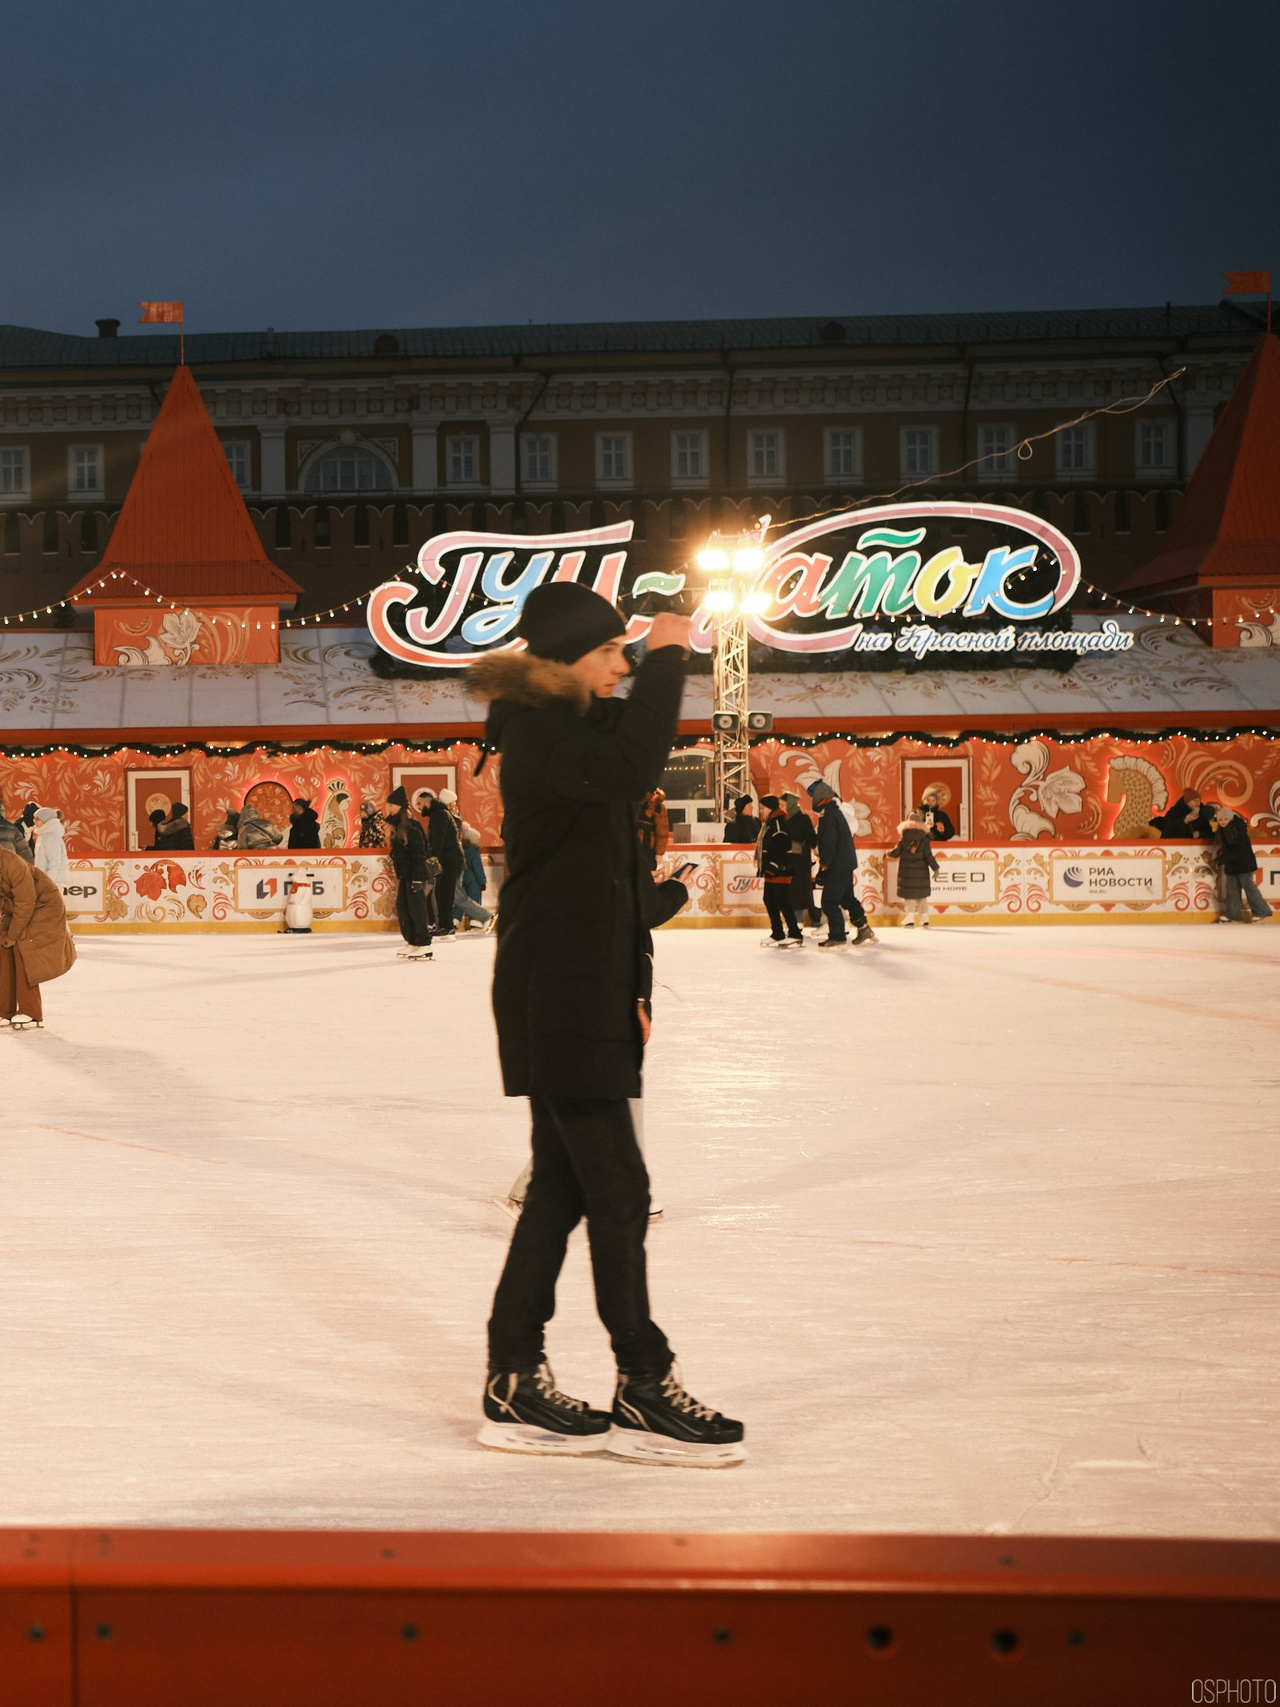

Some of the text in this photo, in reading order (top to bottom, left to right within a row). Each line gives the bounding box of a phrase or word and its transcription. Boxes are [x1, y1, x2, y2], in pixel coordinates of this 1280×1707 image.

[855, 620, 1133, 660] на Красной площади
[1089, 867, 1115, 876] РИА
[934, 872, 985, 883] EED
[1089, 877, 1153, 887] НОВОСТИ
[283, 881, 324, 896] ПБ
